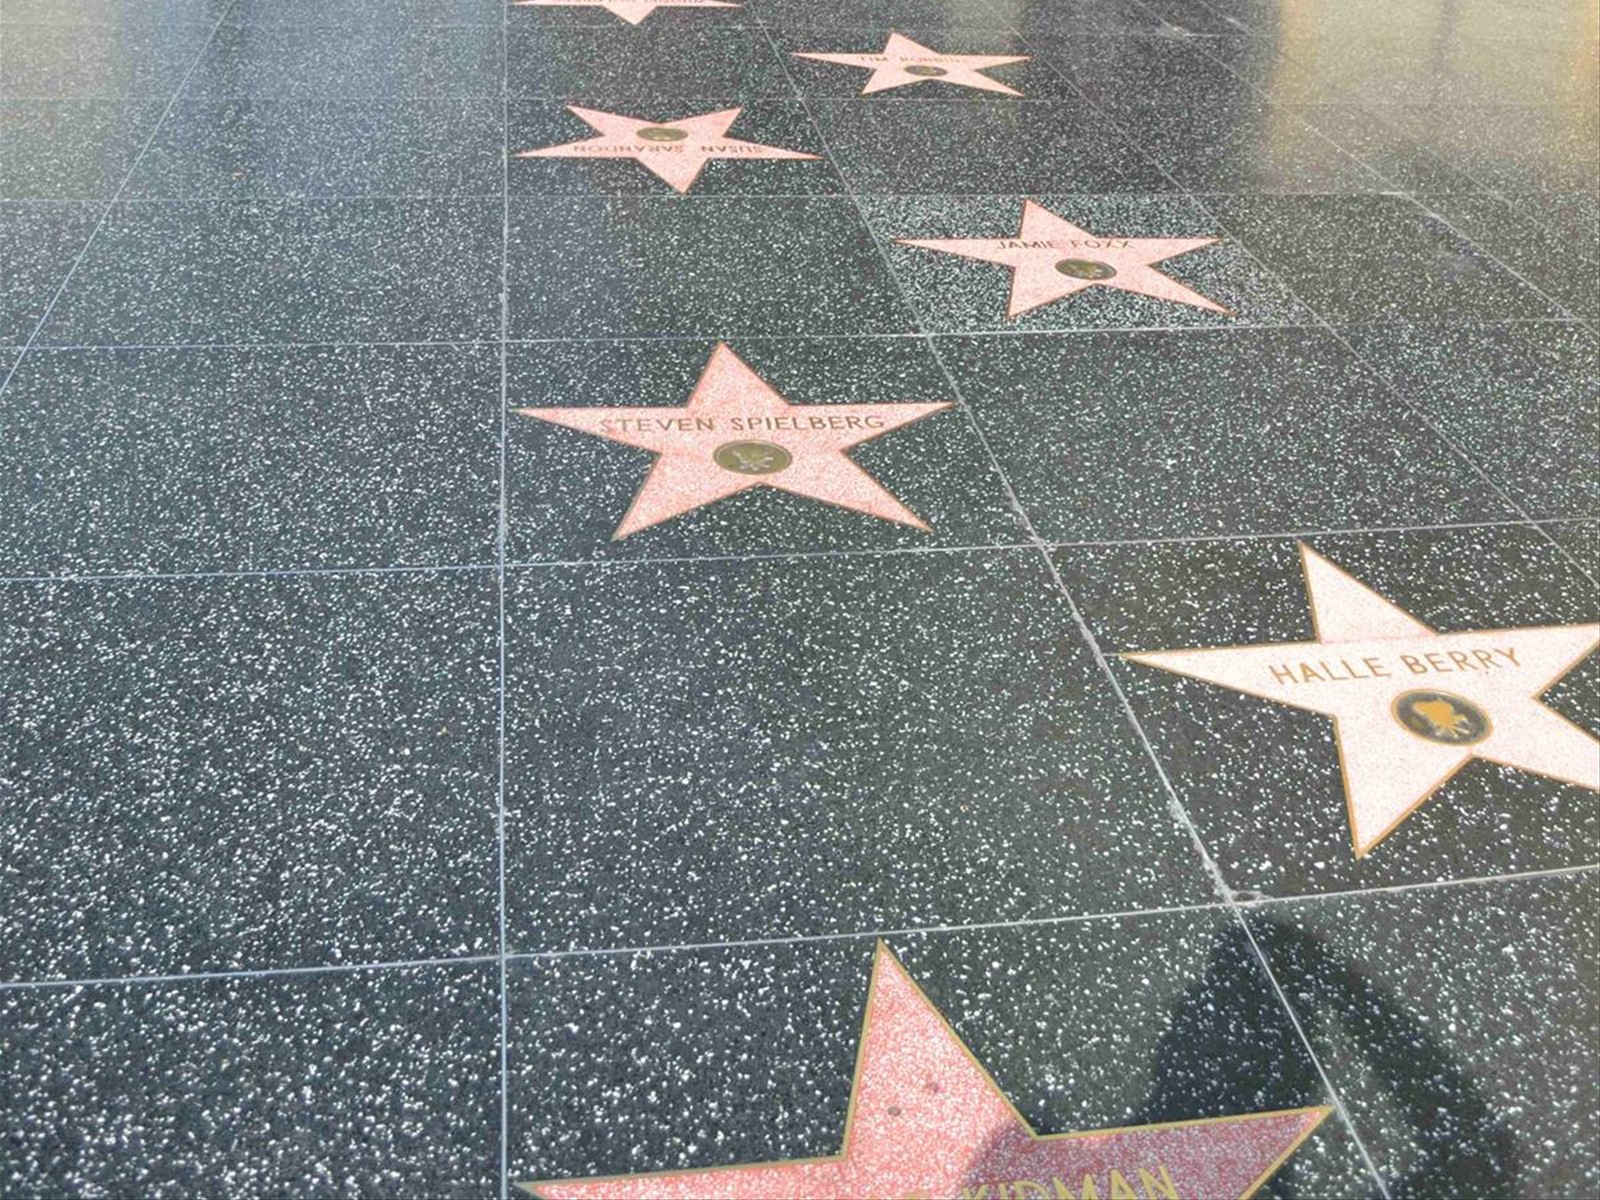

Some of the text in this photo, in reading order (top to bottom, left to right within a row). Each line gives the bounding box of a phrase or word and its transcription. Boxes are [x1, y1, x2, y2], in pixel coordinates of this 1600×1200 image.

[573, 145, 763, 154] SUSAN SARANDON
[998, 239, 1137, 250] JAMIE FOXX
[600, 415, 886, 433] STEVEN SPIELBERG
[1268, 647, 1522, 686] HALLE BERRY
